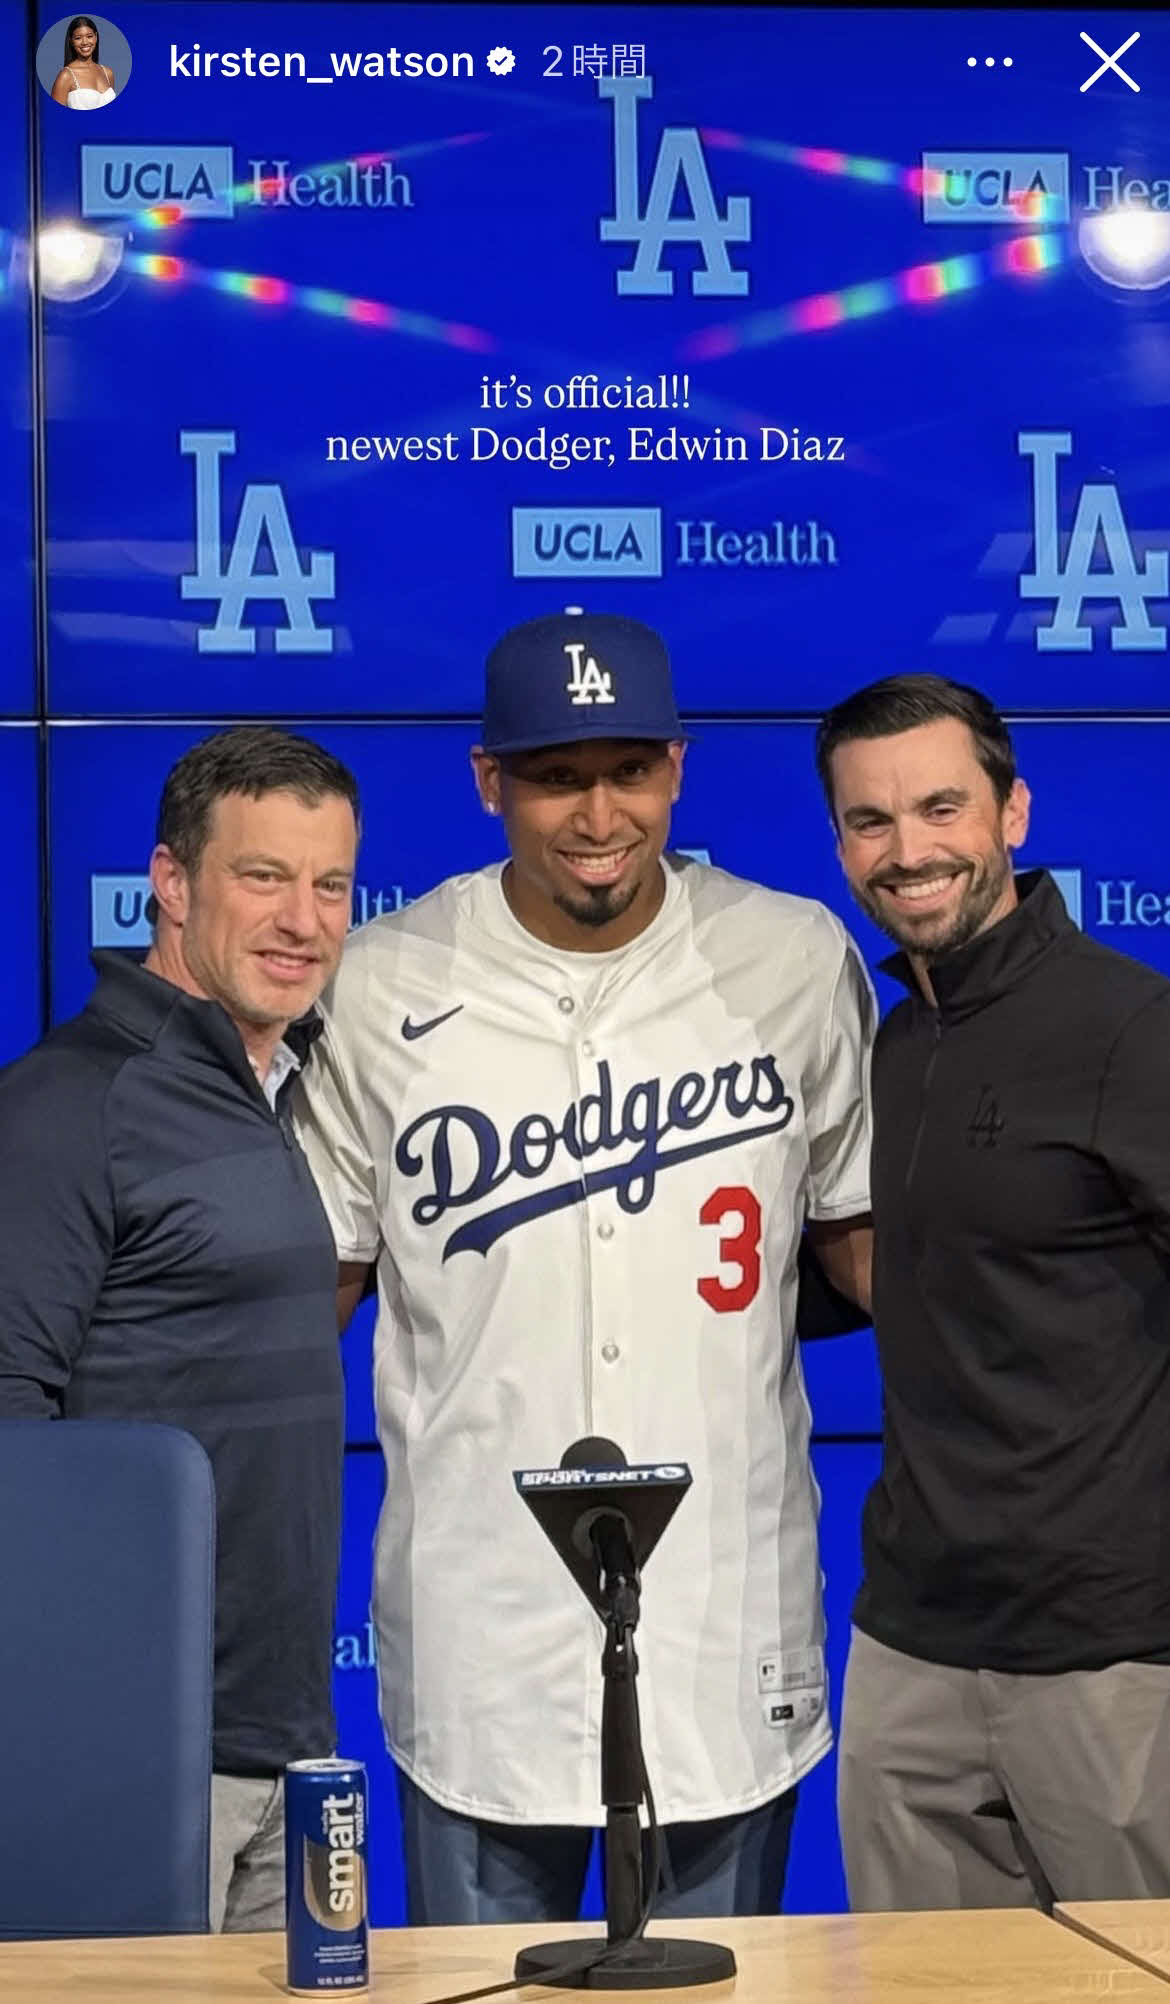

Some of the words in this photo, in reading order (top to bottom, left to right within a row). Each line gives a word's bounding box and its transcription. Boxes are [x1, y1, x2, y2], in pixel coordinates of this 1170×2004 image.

[104, 163, 214, 200] UCLA
[249, 159, 414, 207] Health
[944, 169, 1050, 206] UCLA
[534, 523, 642, 561] UCLA
[677, 521, 837, 565] Health
[395, 1054, 795, 1264] Dodgers
[697, 1186, 762, 1313] 3
[322, 1793, 355, 1913] smart
